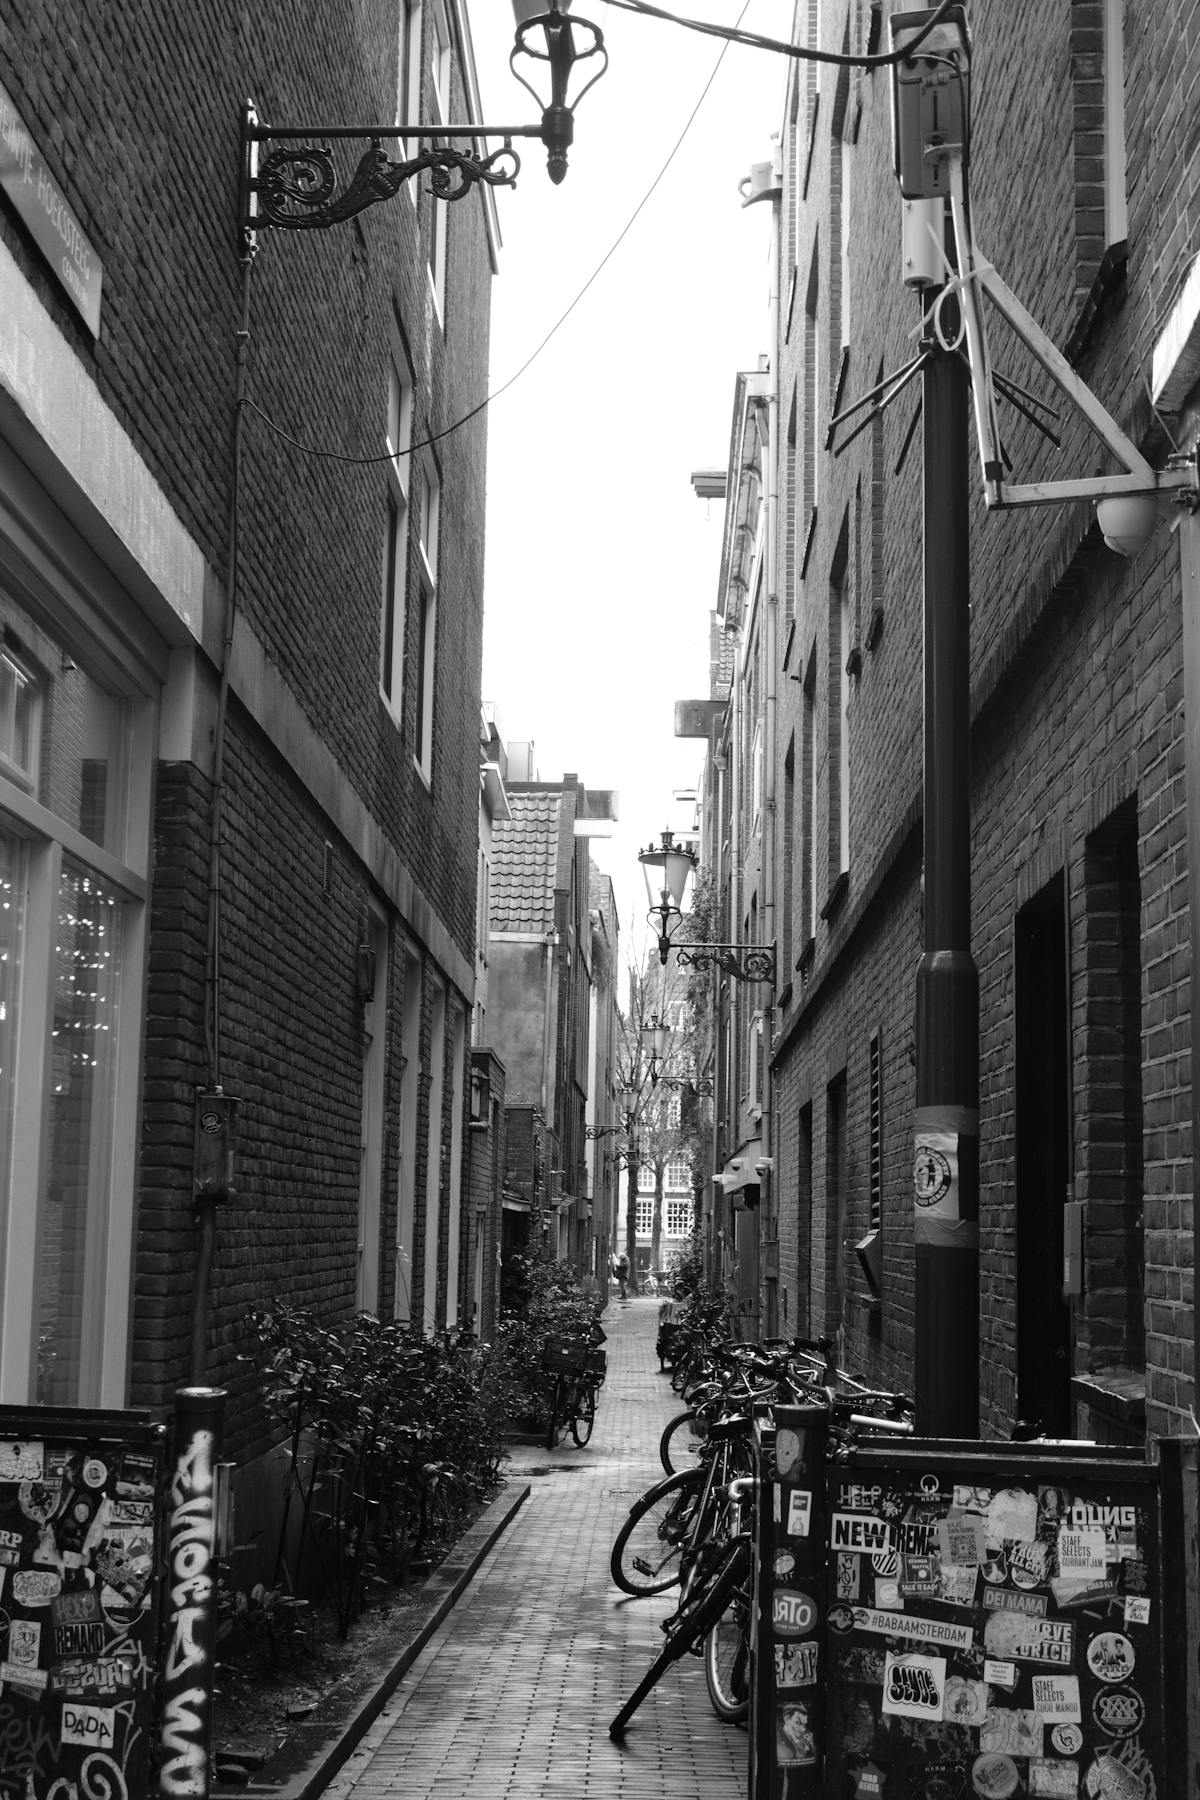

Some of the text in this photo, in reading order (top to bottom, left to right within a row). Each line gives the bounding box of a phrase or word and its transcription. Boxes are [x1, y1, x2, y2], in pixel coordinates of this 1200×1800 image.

[38, 166, 91, 281] HOEKSSTEEG
[1061, 1535, 1081, 1546] STAFF
[1061, 1546, 1091, 1557] SELECTS
[1061, 1557, 1090, 1567] CURRANT
[1006, 1595, 1044, 1615] MAMA
[871, 1615, 967, 1643] #BABAAMSTERDAM
[1034, 1680, 1055, 1693] STAFF
[1034, 1690, 1065, 1703] SELECTS
[1056, 1702, 1078, 1713] MANGO
[64, 1710, 111, 1739] DADA
